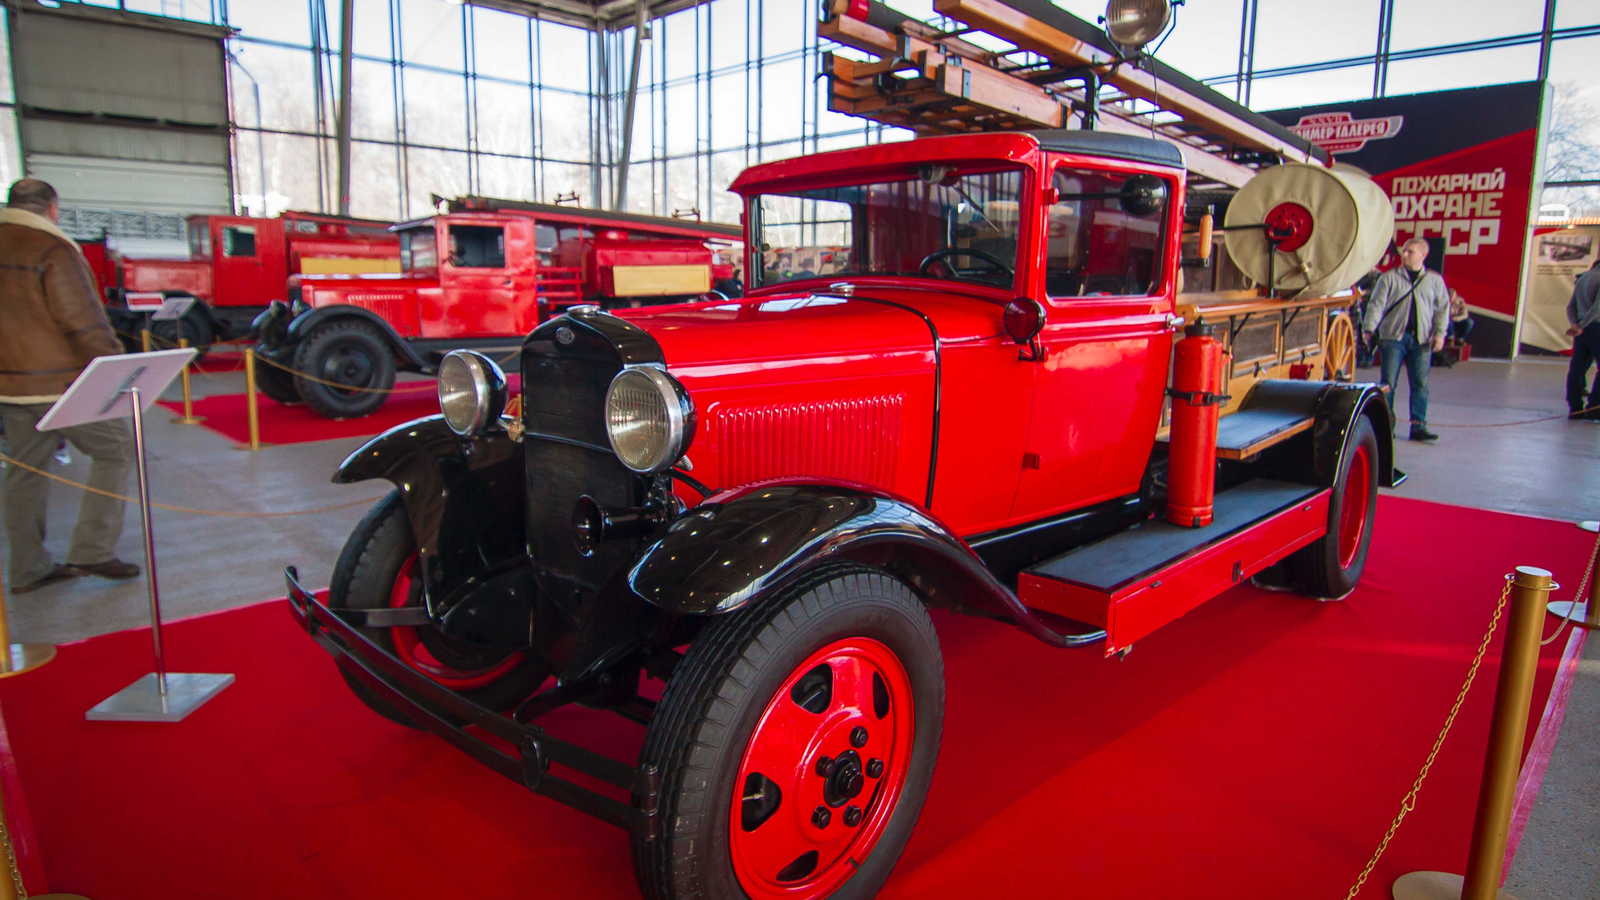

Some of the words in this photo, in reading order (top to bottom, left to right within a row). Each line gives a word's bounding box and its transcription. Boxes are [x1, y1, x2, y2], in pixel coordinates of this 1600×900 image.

[1335, 121, 1386, 139] ГАЛЕРЕЯ
[1391, 167, 1506, 195] ПОЖАРНОЙ
[1391, 191, 1504, 220] ОХРАНЕ
